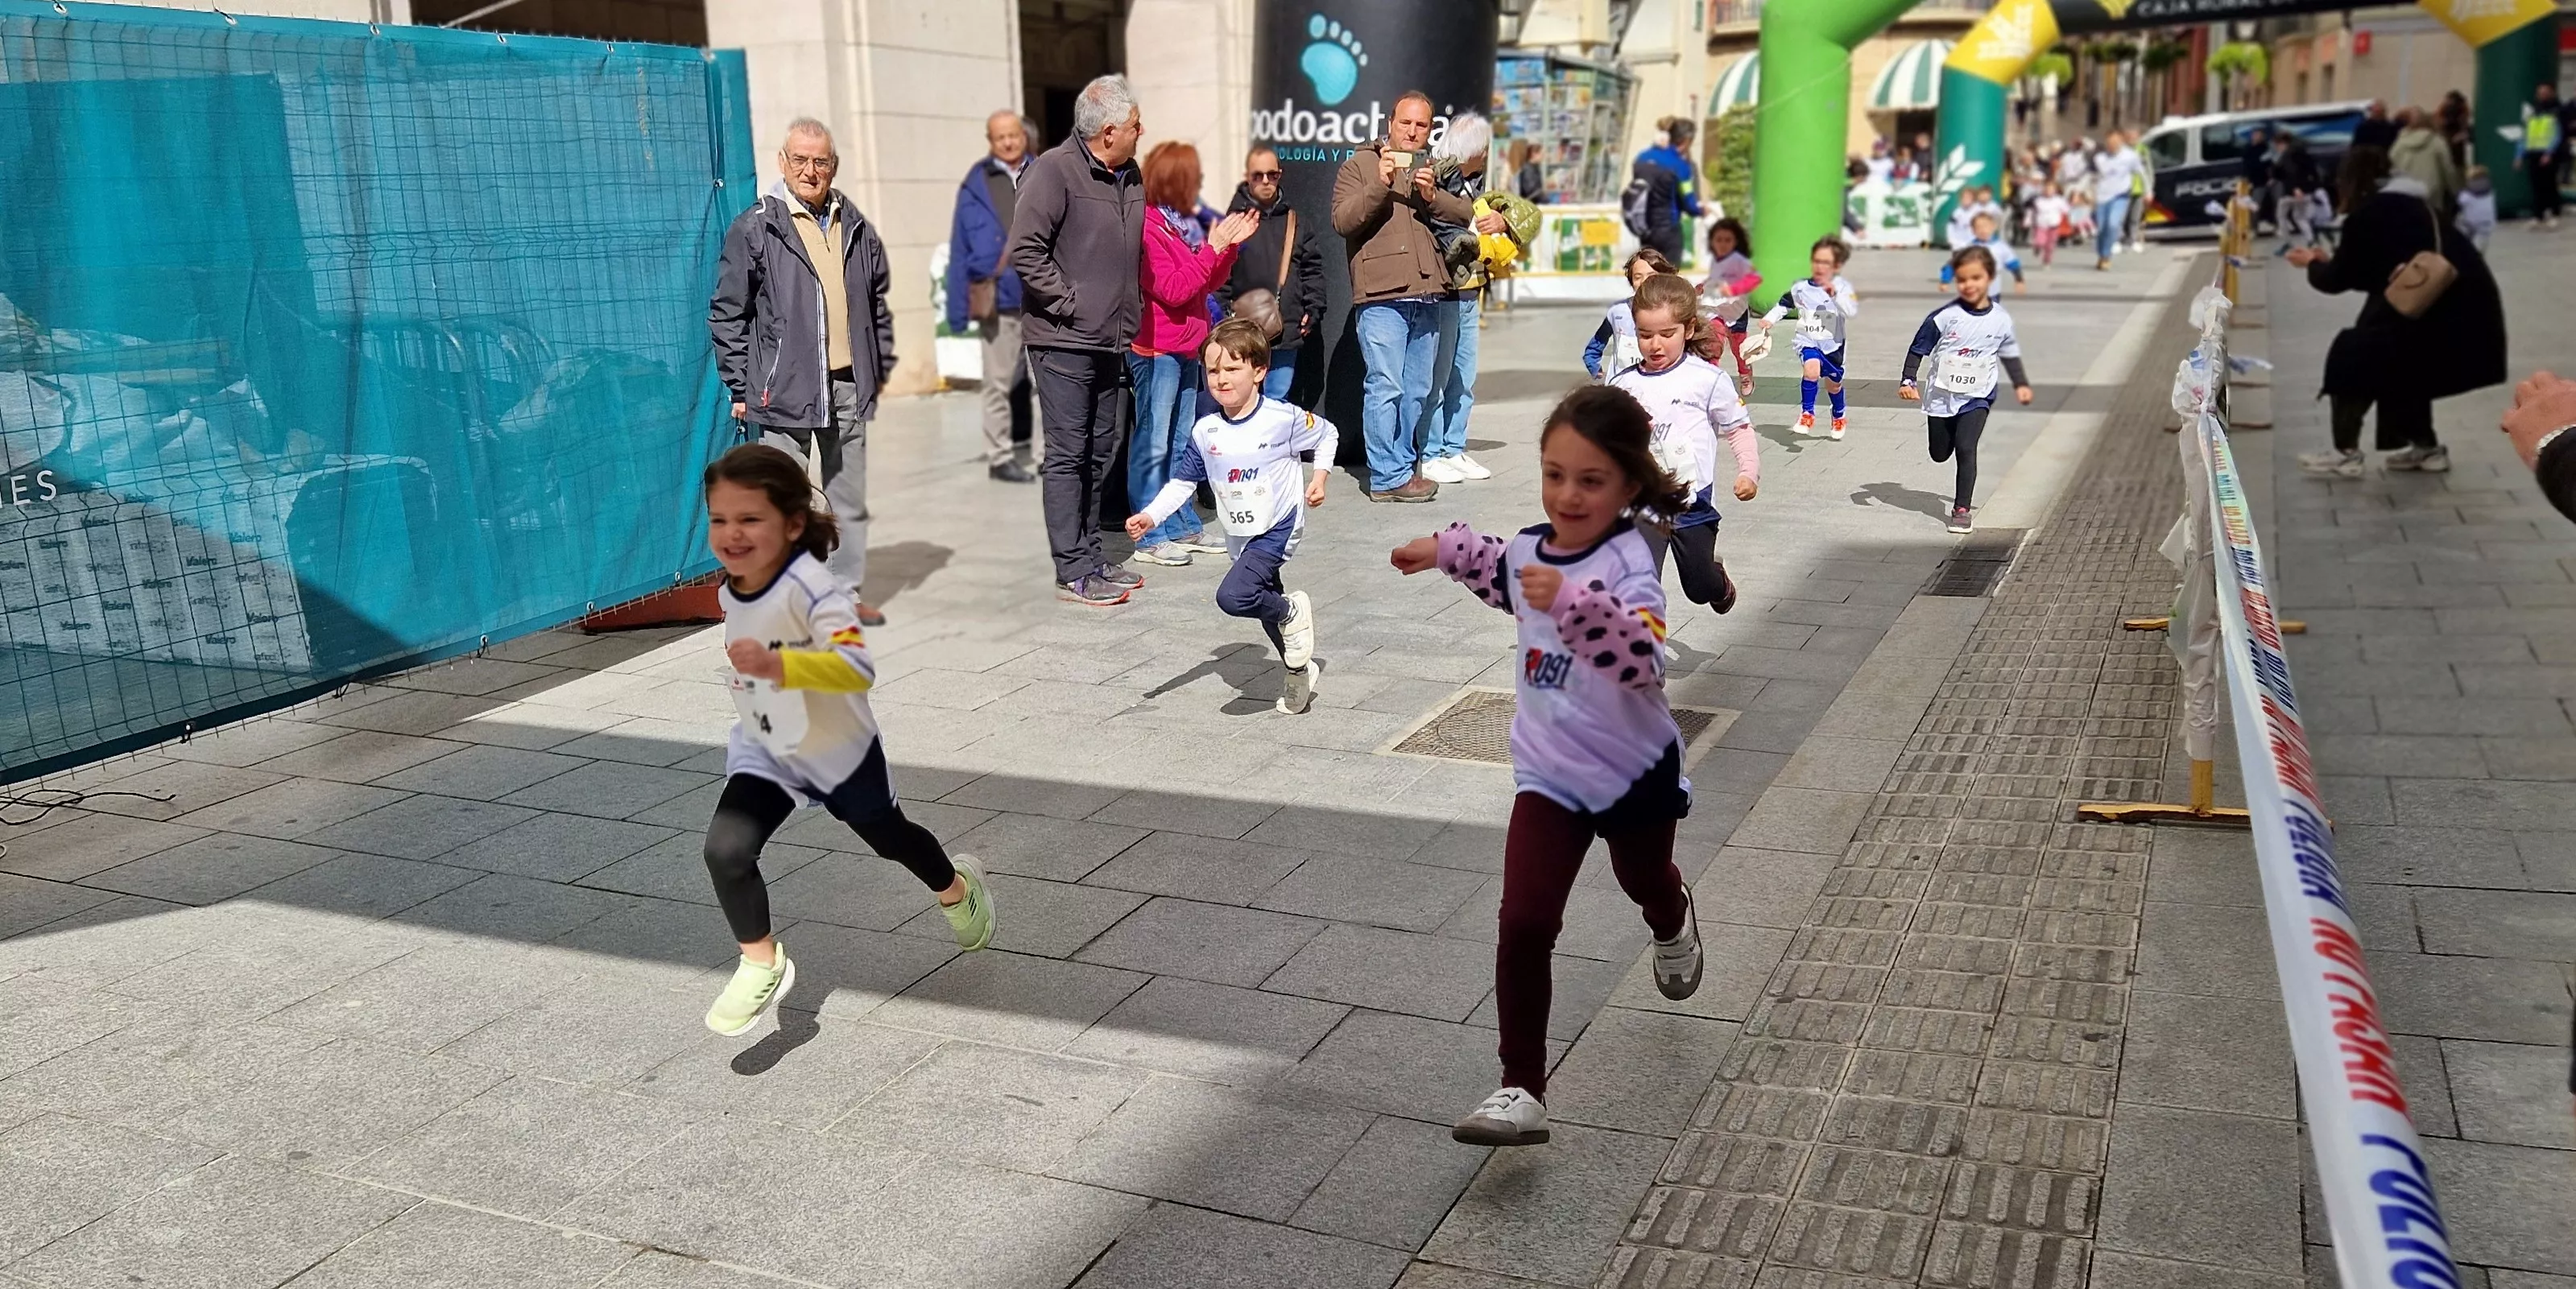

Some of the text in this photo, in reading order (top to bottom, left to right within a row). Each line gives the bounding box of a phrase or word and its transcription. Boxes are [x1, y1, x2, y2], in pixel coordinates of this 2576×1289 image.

[1251, 97, 1449, 147] odoacta
[1278, 146, 1326, 162] OLOGÍA
[1331, 148, 1341, 162] Y
[1950, 374, 1976, 385] 1030
[0, 469, 56, 508] ES
